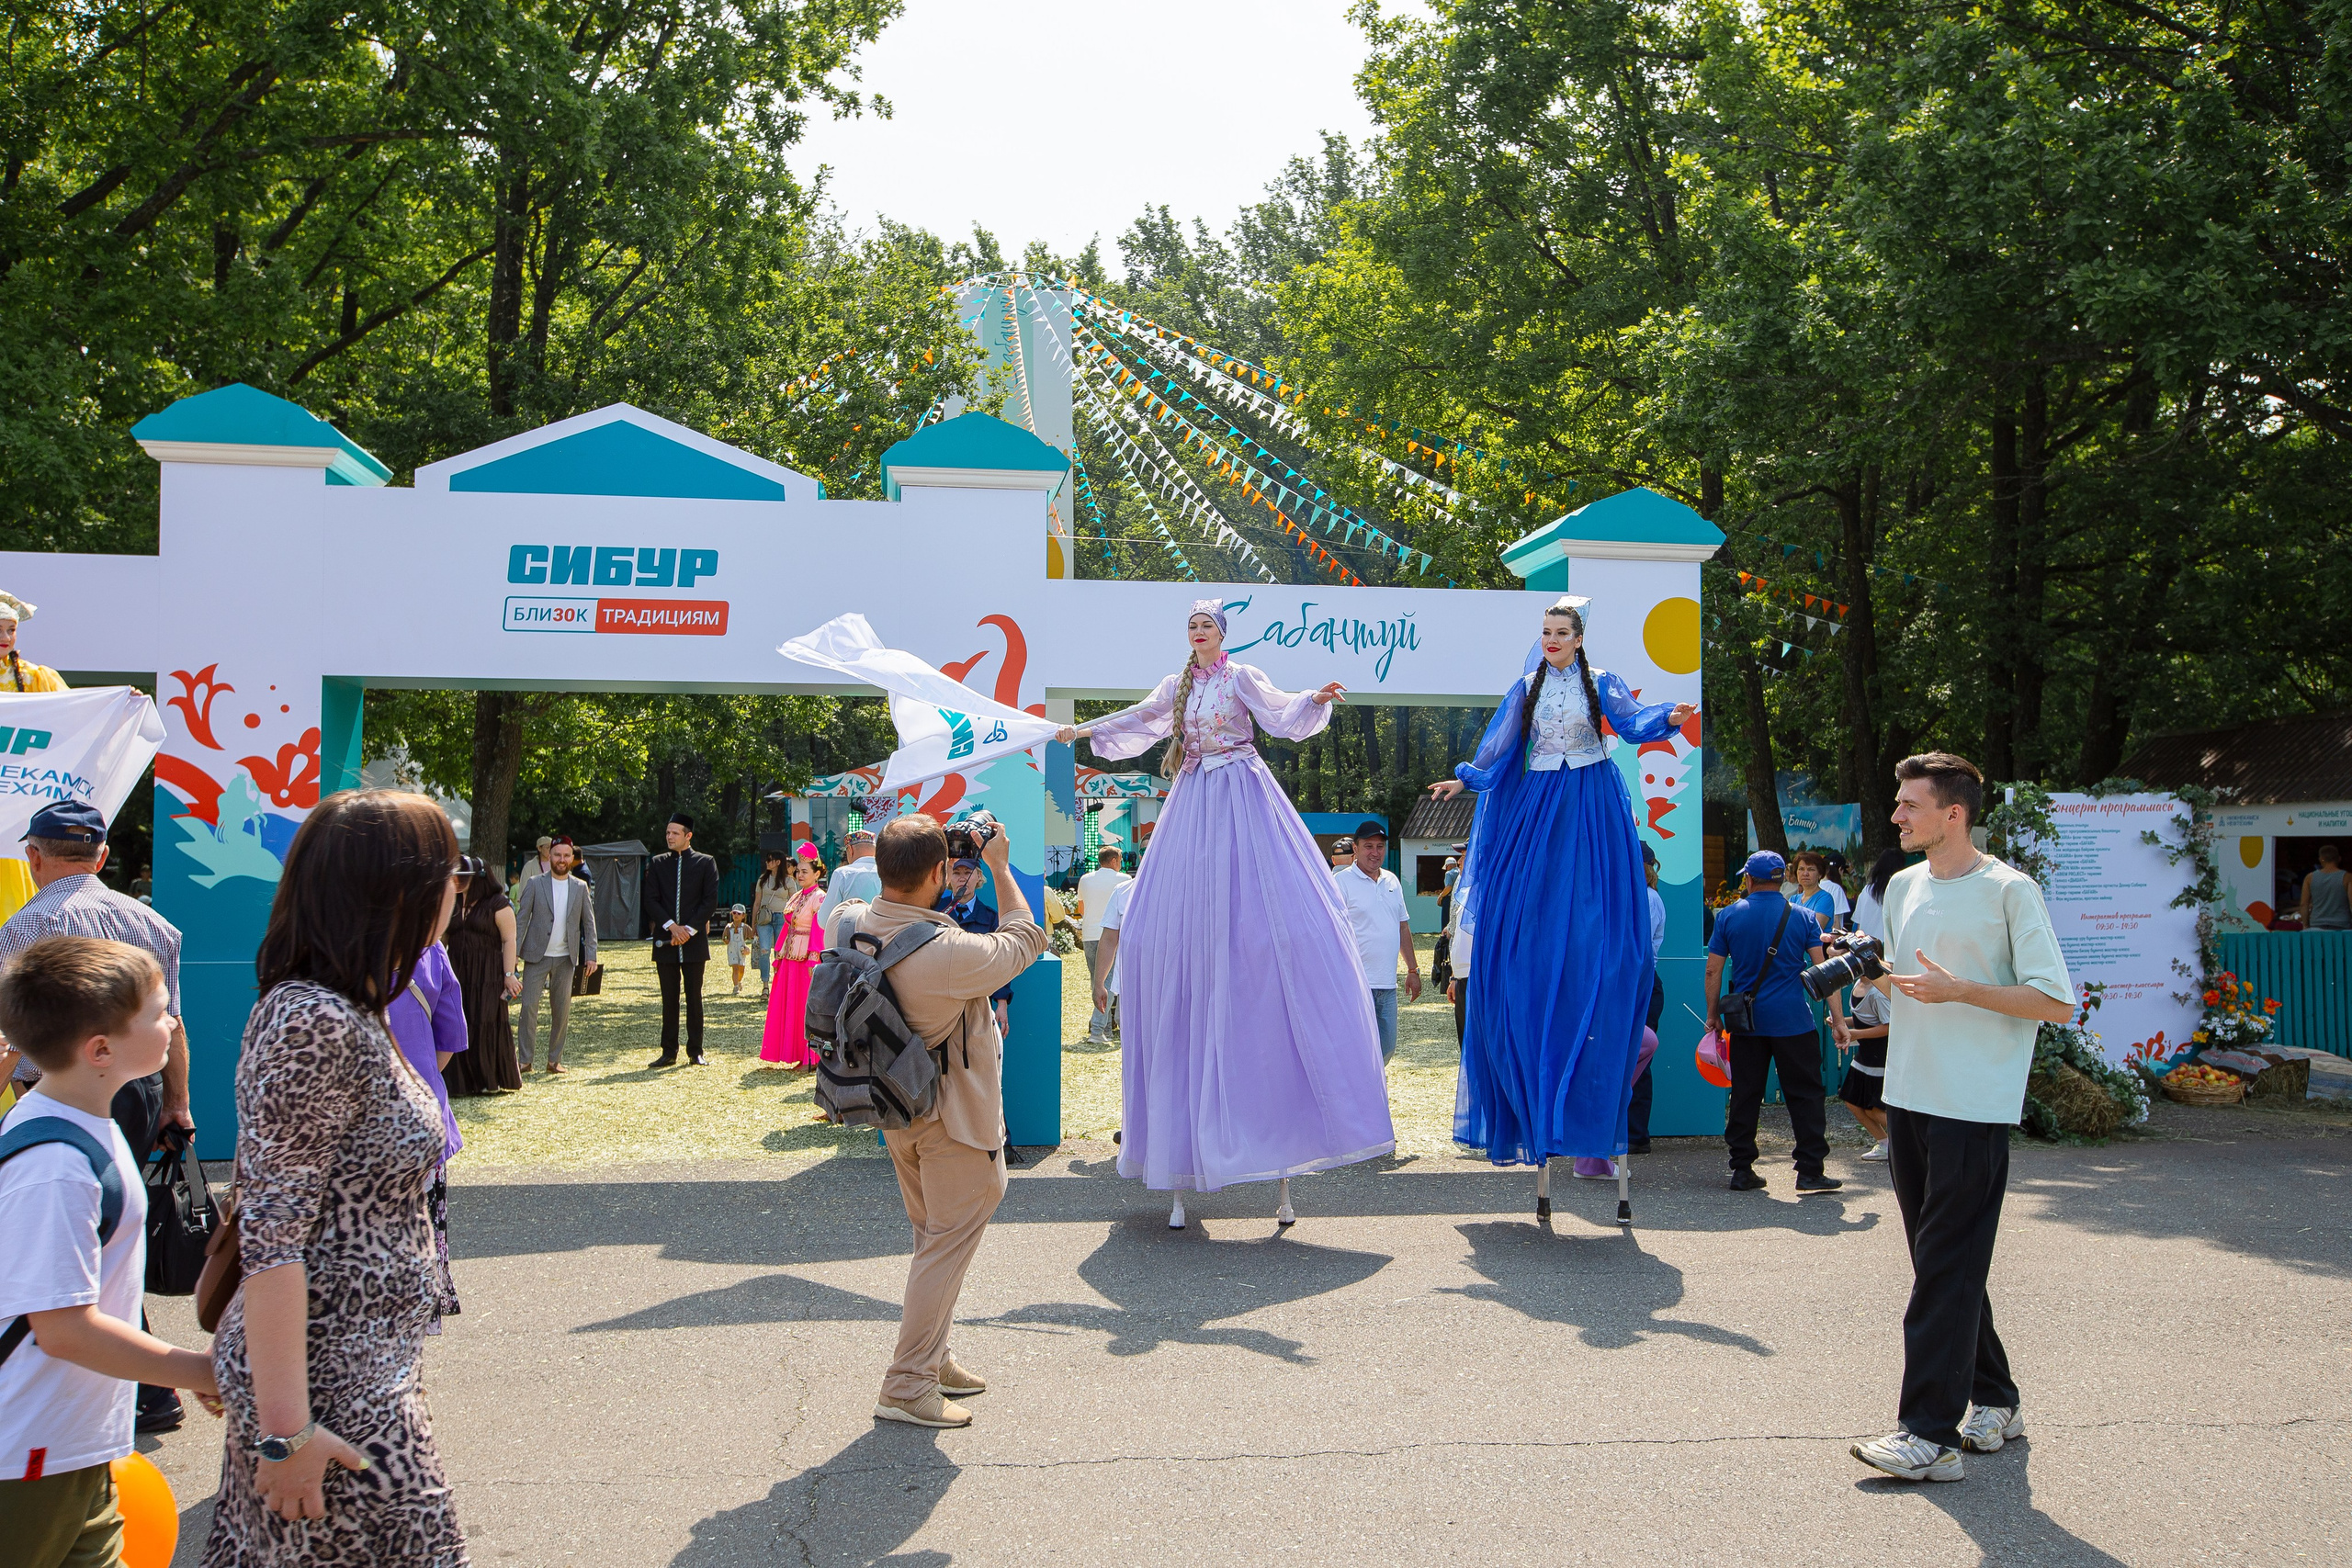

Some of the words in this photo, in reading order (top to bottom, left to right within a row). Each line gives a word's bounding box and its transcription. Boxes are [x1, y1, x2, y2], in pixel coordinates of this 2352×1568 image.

[507, 545, 719, 588] СИБУР
[602, 608, 720, 627] ТРАДИЦИЯМ
[1222, 594, 1422, 683] Сабантуй
[2099, 802, 2174, 818] программасы
